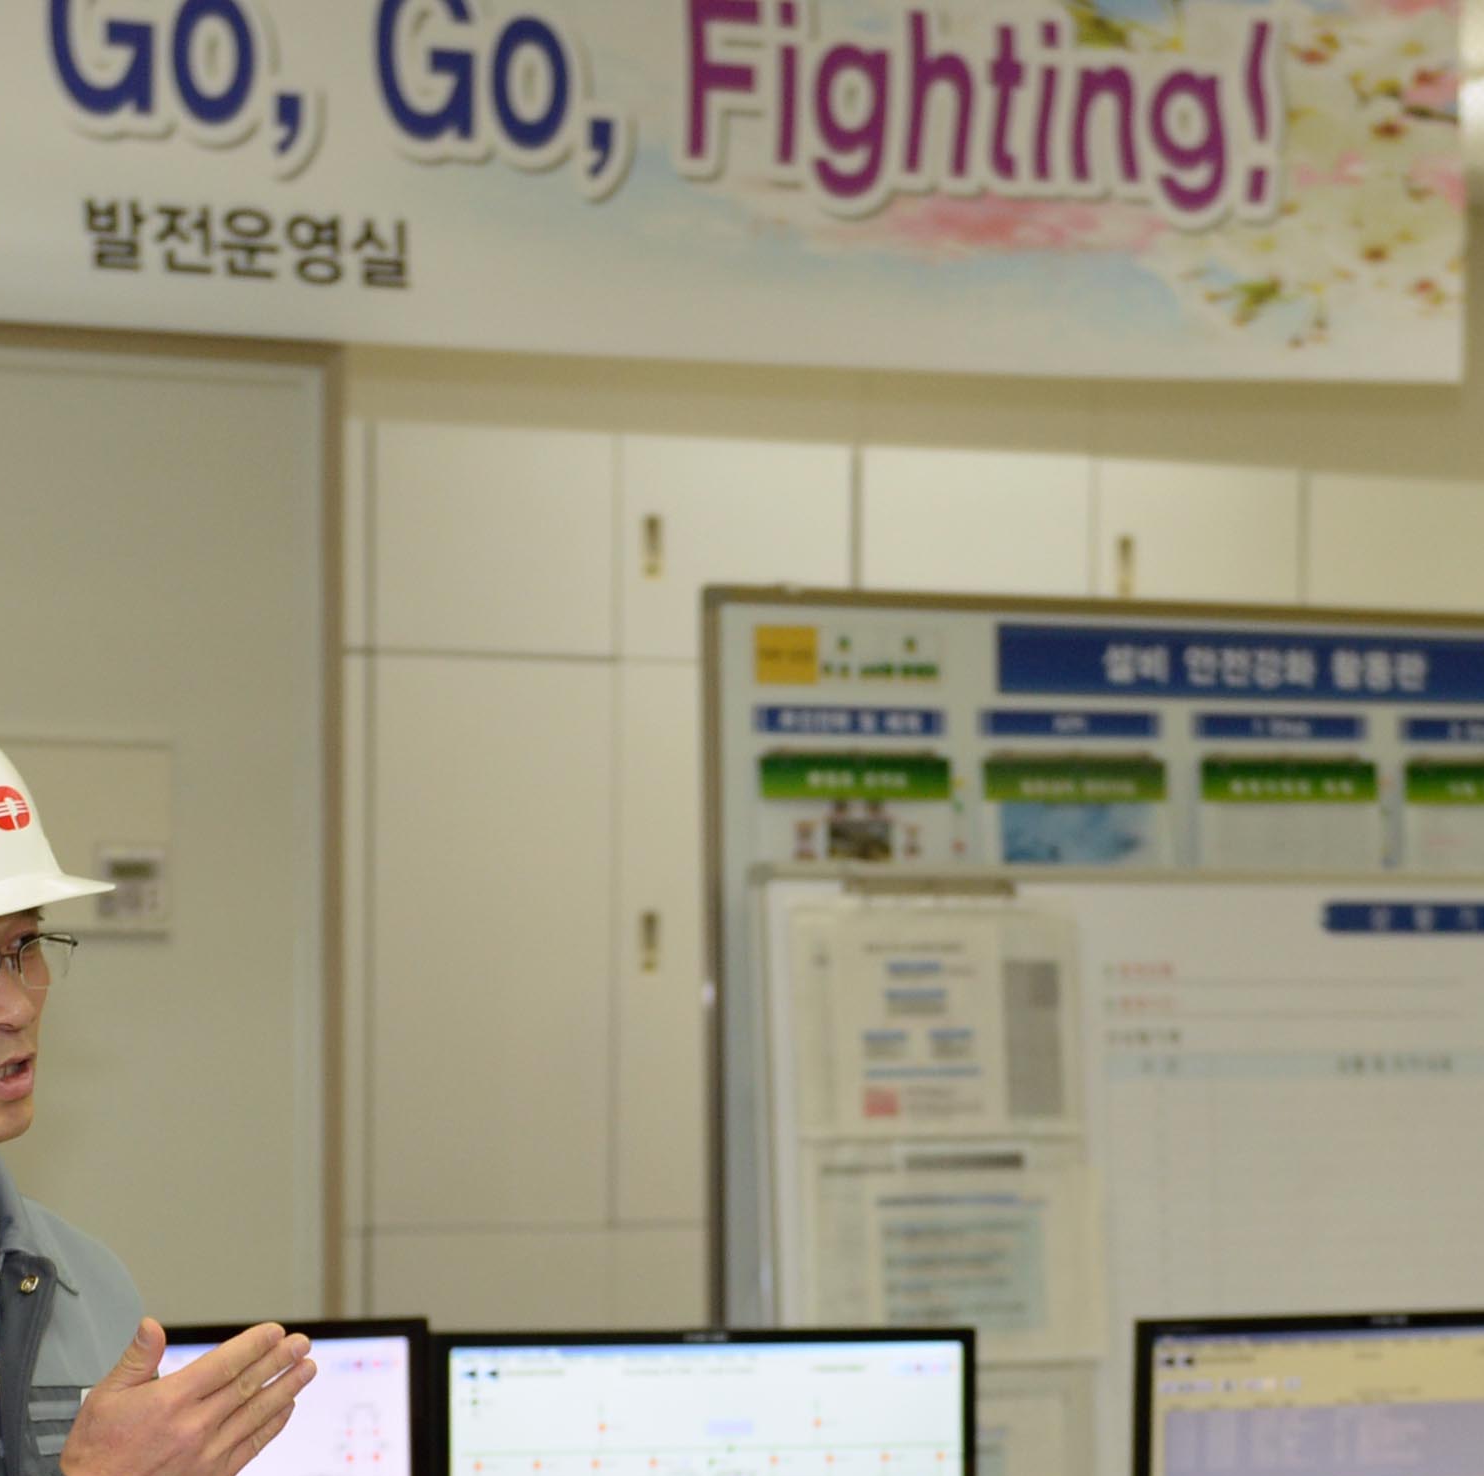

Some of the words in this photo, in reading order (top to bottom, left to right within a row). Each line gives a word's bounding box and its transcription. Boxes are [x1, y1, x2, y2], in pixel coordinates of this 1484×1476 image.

[49, 0, 301, 154] Go,
[377, 0, 613, 177] Go,
[688, 0, 1270, 211] Fighting!
[84, 197, 410, 290] 발전운영실
